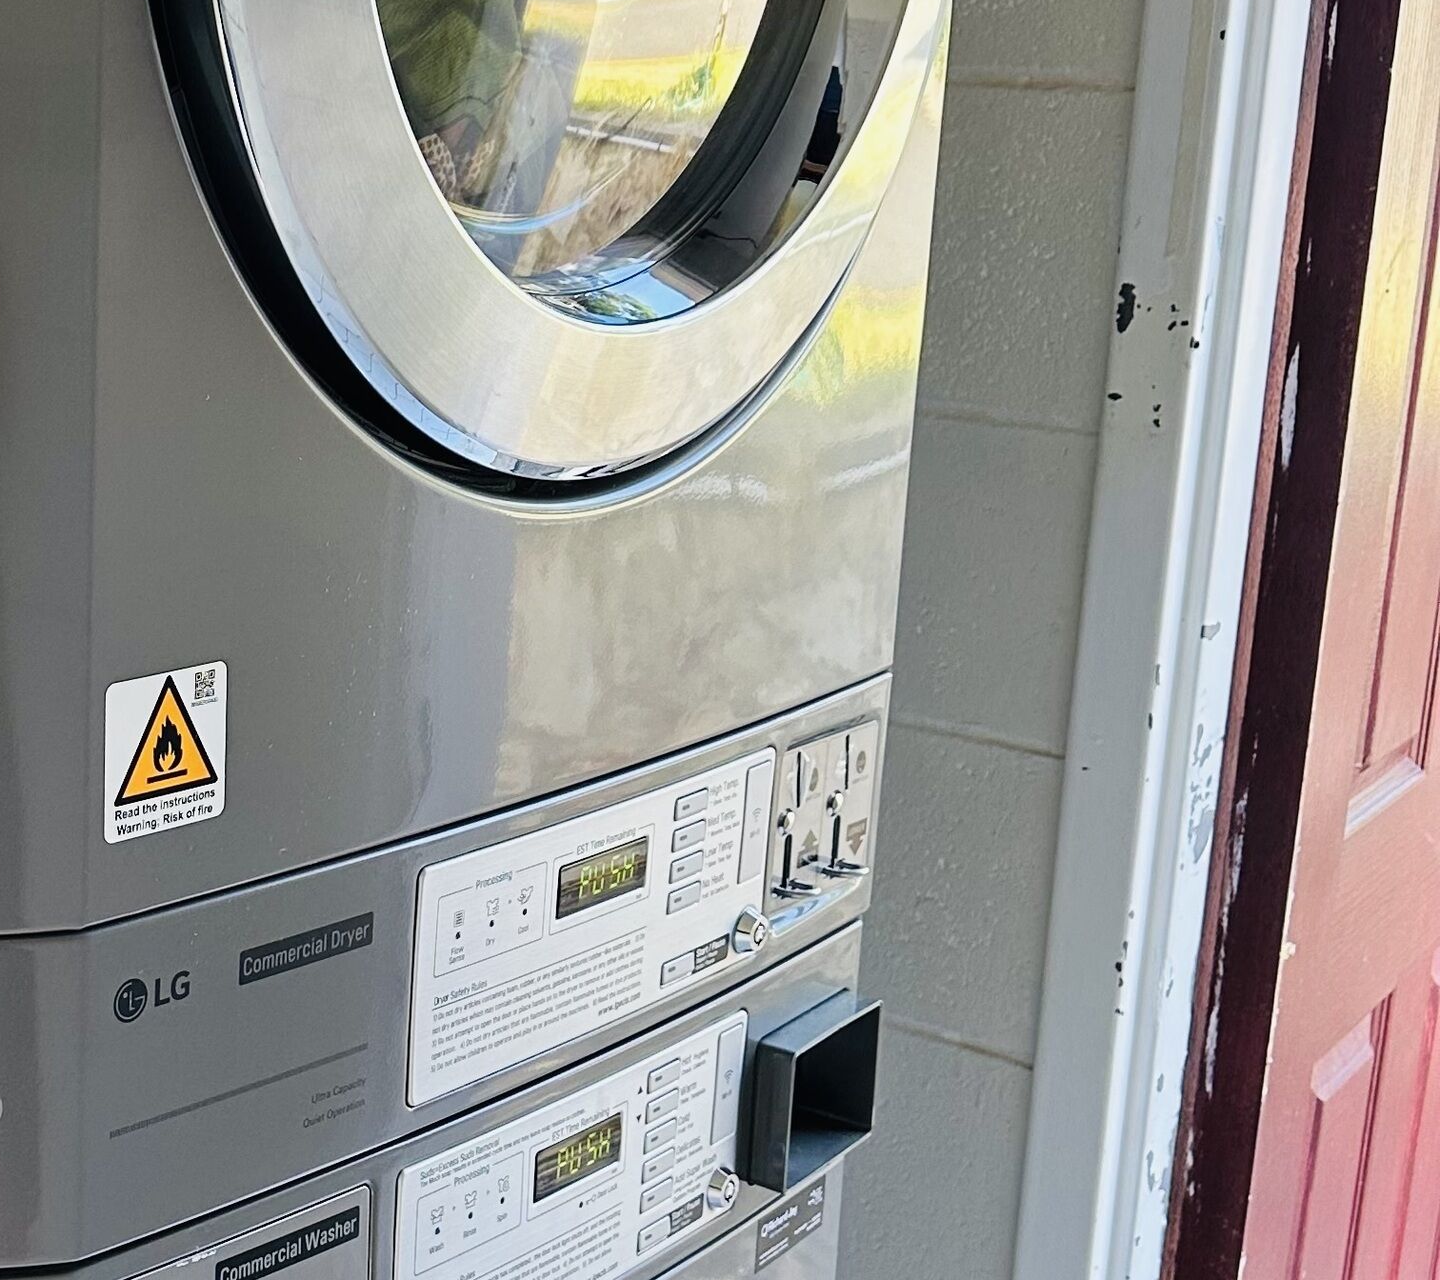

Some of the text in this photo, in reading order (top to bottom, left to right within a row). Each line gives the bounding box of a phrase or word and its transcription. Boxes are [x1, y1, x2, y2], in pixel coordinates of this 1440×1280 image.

[115, 806, 140, 821] Read
[143, 801, 157, 814] the
[163, 811, 184, 825] Risk
[186, 807, 196, 819] of
[197, 804, 213, 816] fire
[475, 870, 513, 890] Processing
[579, 852, 636, 899] PUSH
[242, 923, 371, 977] Commercial Dryer
[154, 970, 191, 1007] LG
[556, 1127, 611, 1179] PUSH
[305, 1216, 357, 1248] Washer
